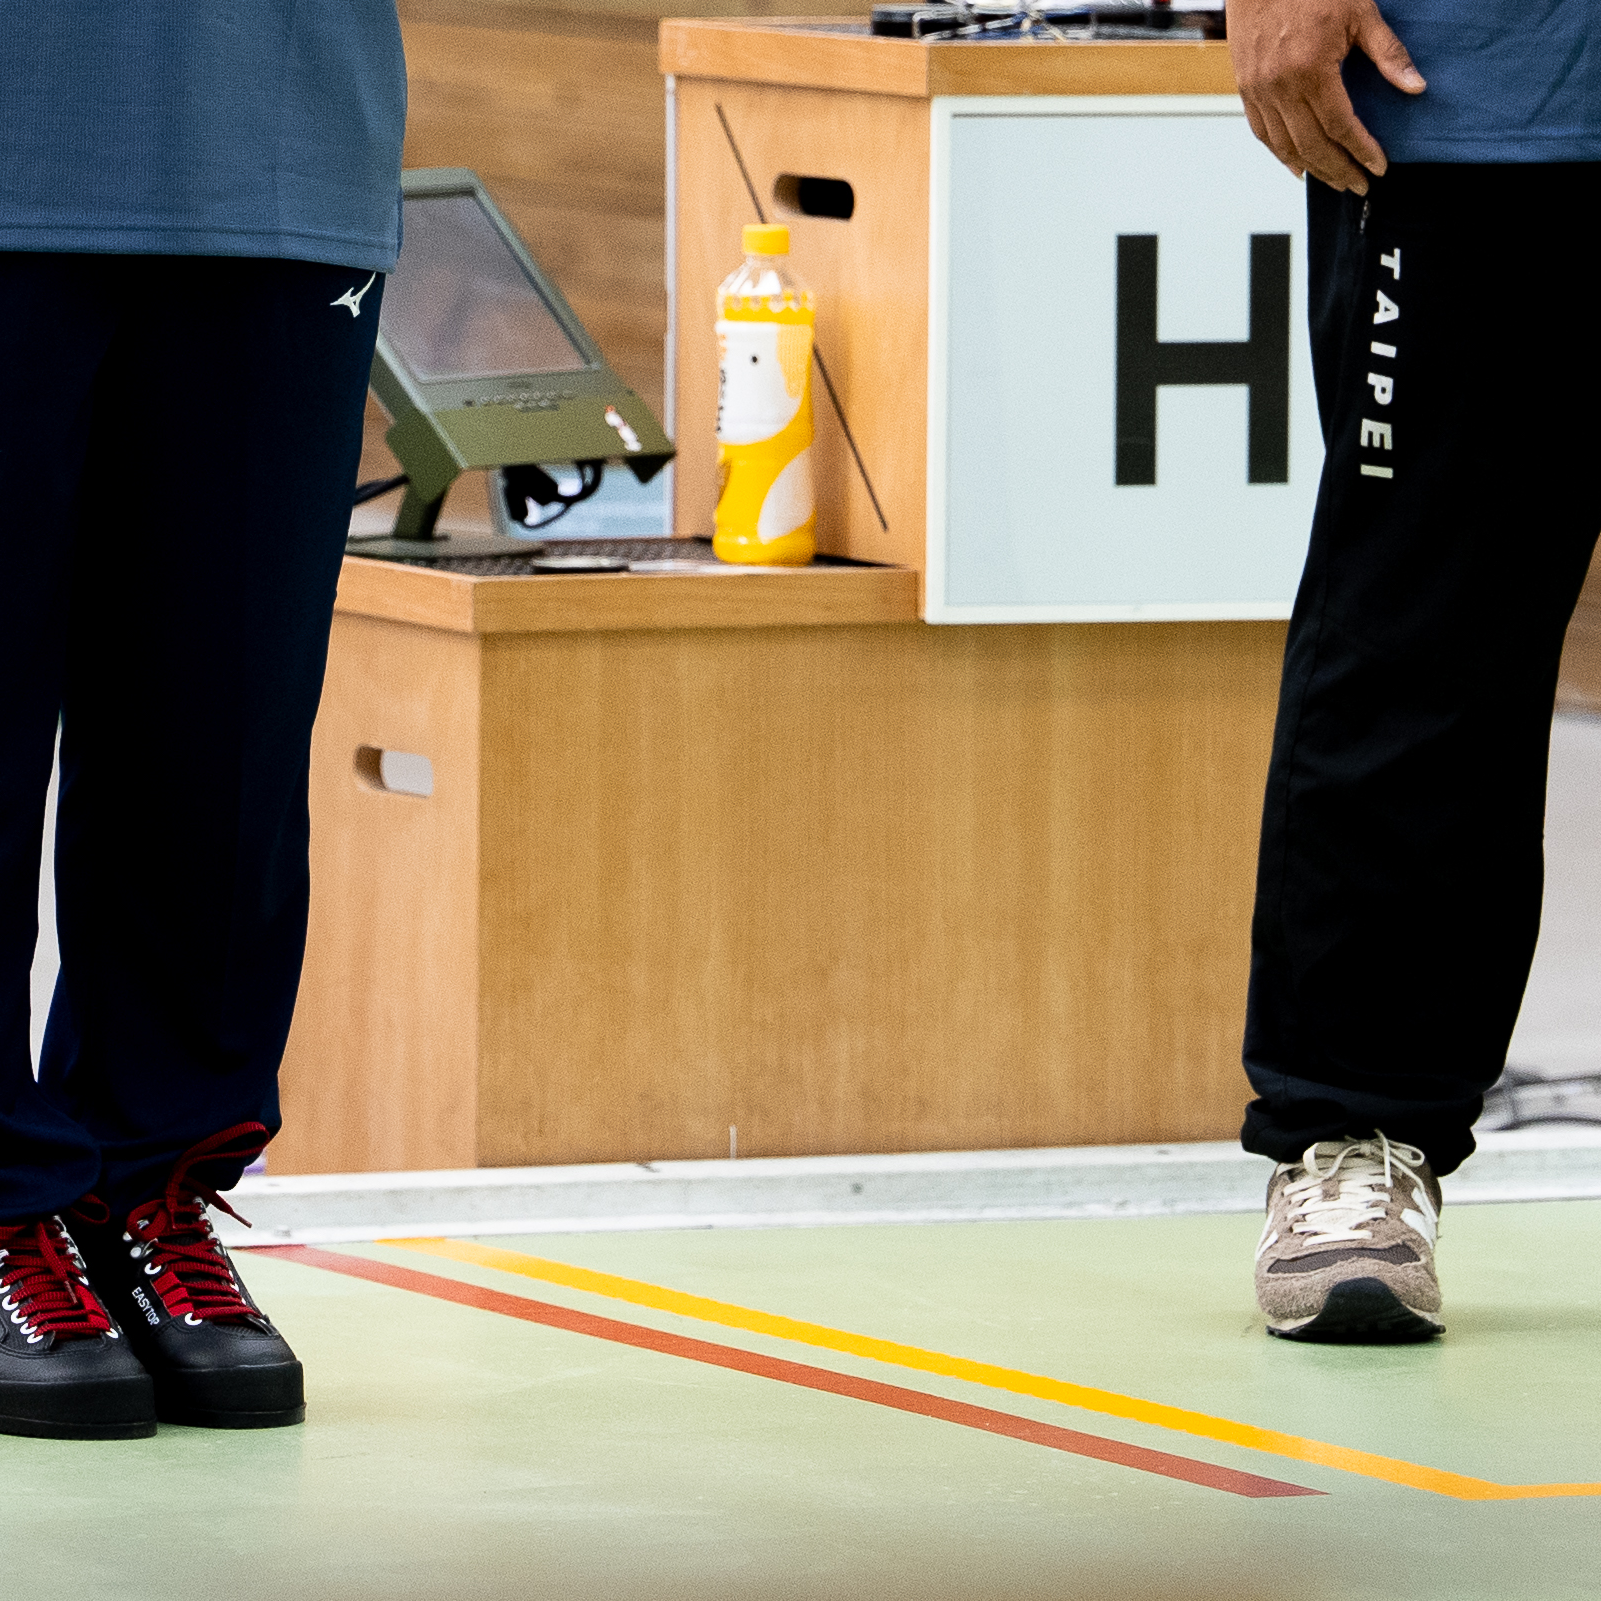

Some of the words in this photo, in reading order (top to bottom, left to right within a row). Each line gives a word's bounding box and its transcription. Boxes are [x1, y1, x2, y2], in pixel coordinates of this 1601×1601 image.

[1114, 232, 1292, 487] H
[1360, 247, 1401, 479] TAIPEI
[131, 1286, 160, 1326] EASYTOP
